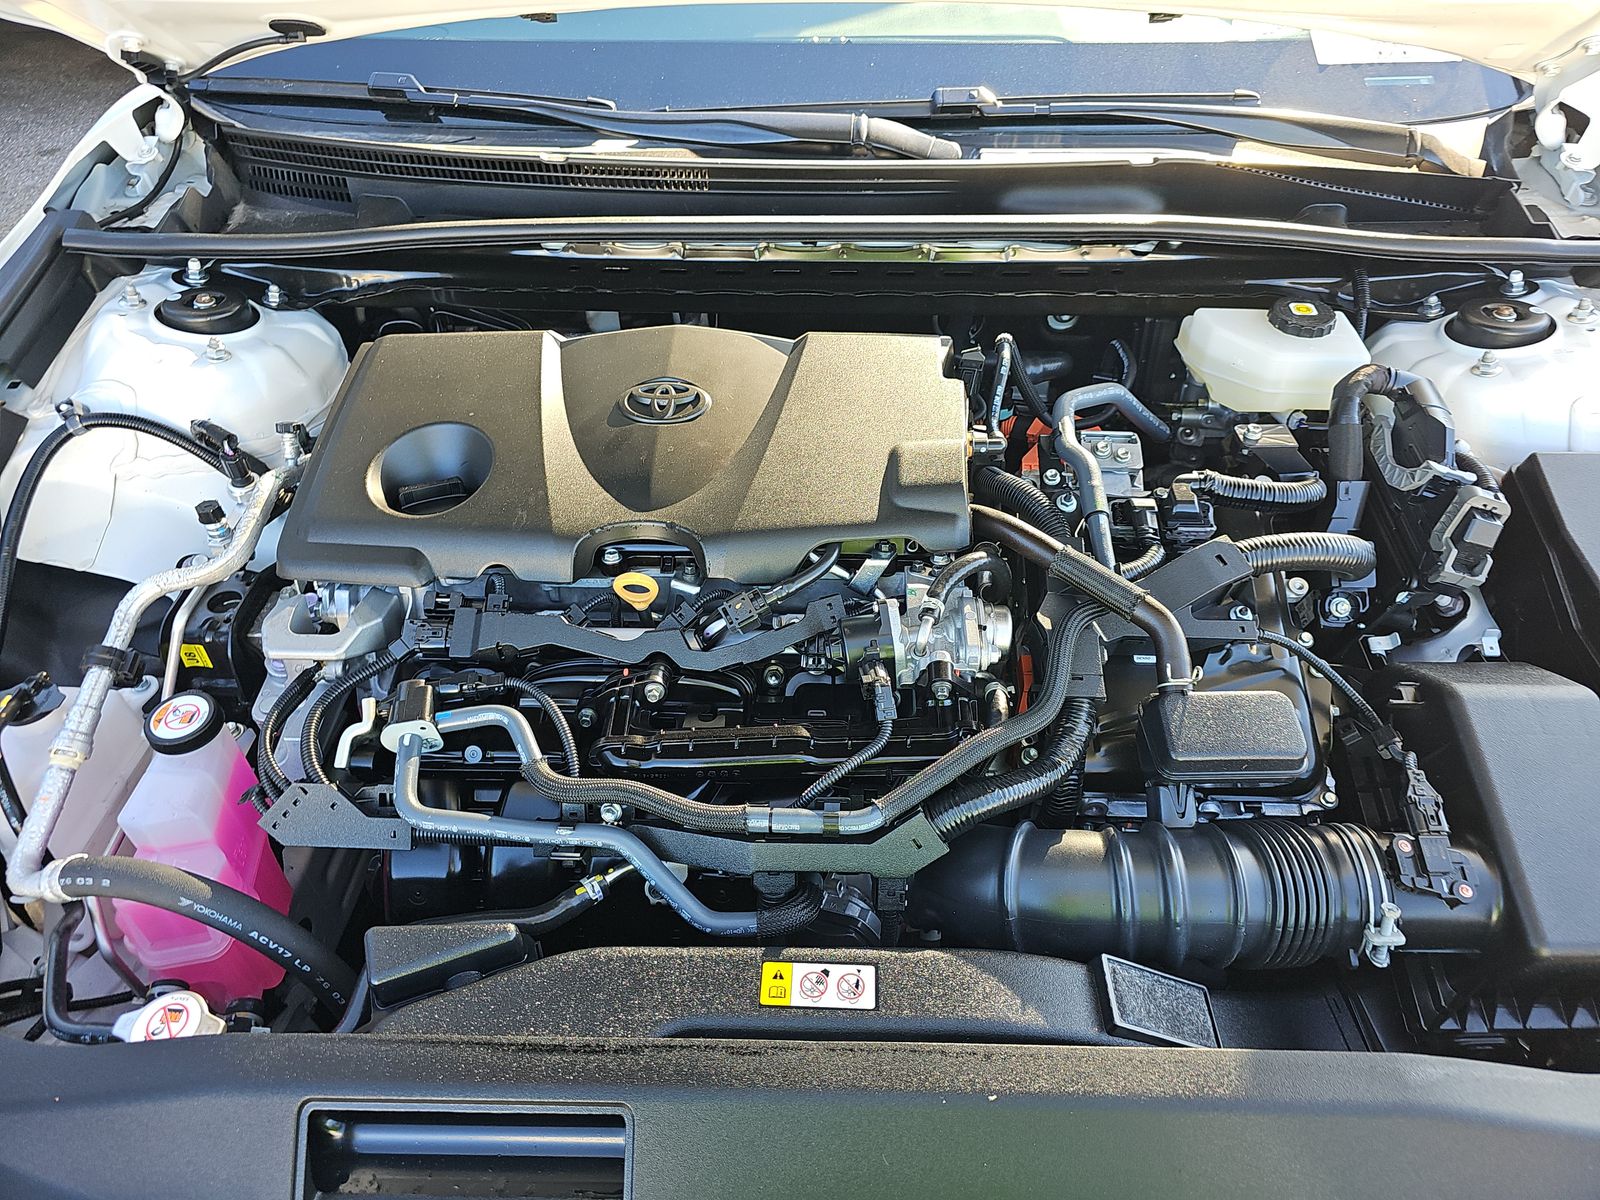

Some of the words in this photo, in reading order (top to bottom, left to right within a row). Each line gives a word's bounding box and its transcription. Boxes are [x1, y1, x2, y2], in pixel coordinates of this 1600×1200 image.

[193, 902, 243, 931] YOKOHAMA
[248, 930, 292, 958] ACV17
[294, 958, 312, 973] LP
